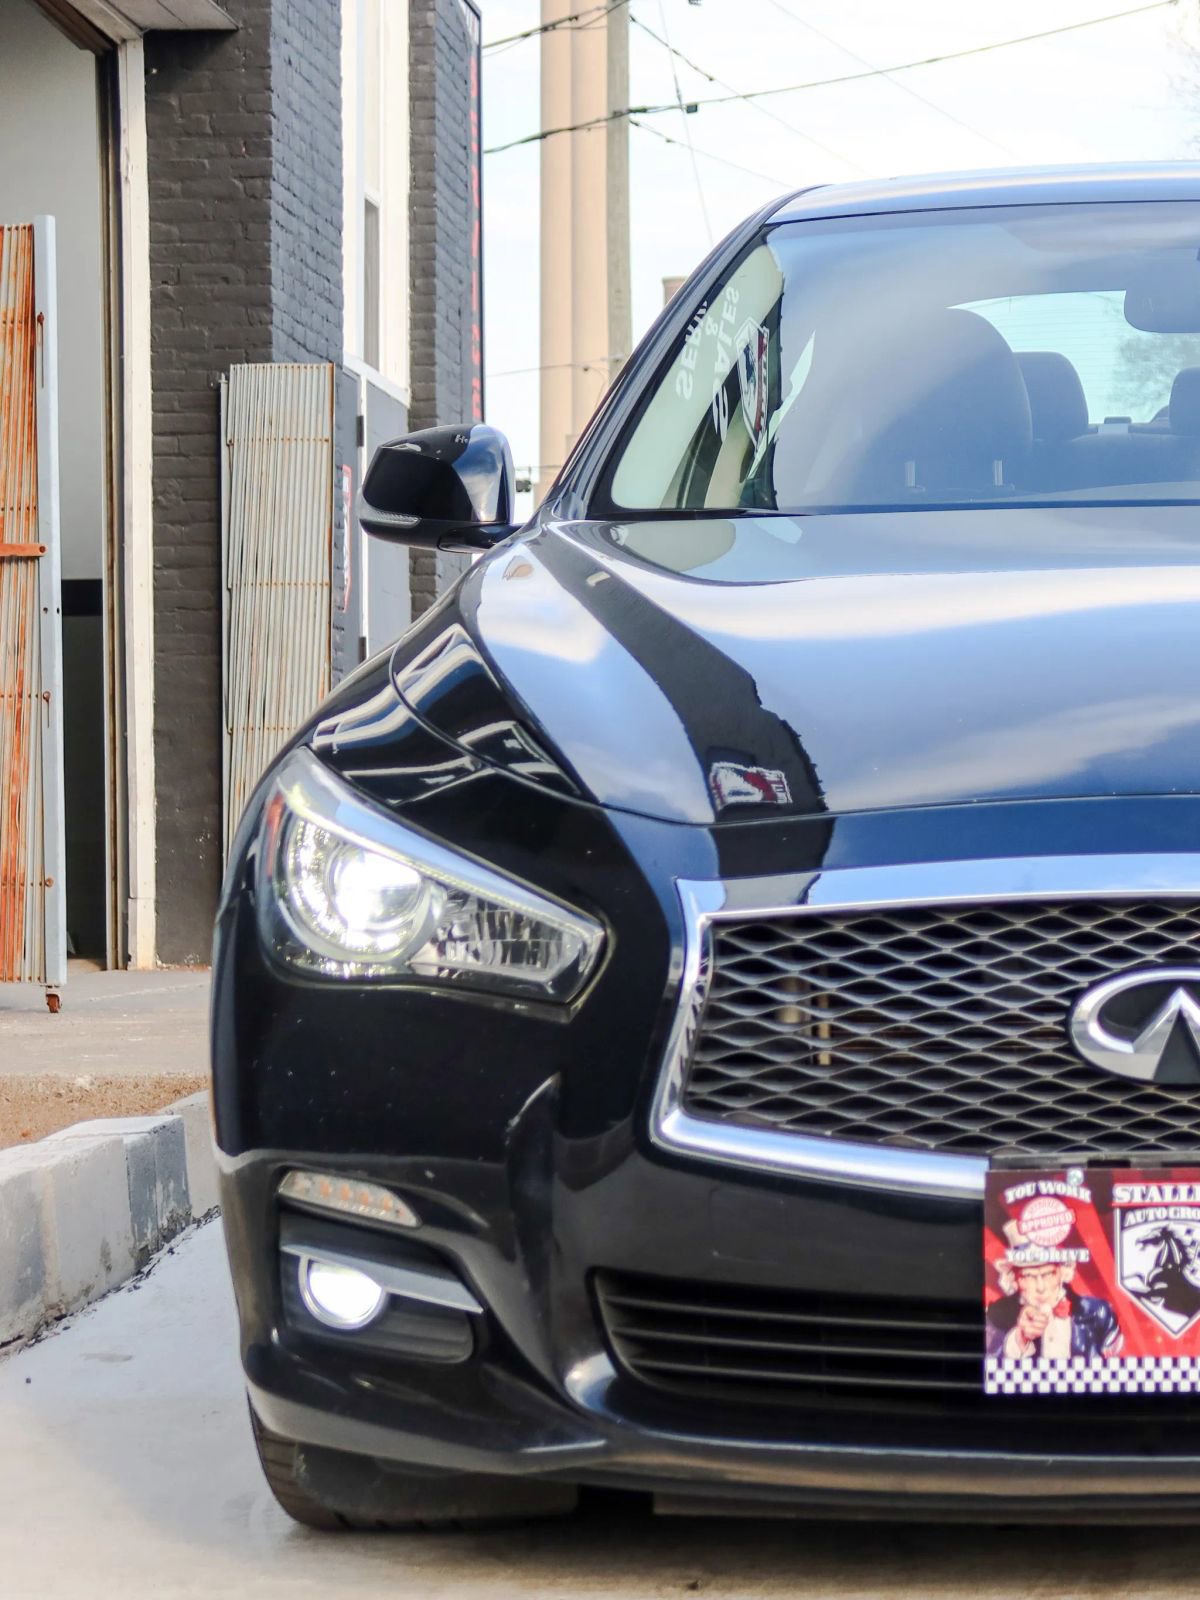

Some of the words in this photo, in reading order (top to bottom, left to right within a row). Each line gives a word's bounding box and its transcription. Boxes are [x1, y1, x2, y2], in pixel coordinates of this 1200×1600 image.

[1004, 1182, 1037, 1204] YOU
[1038, 1180, 1092, 1204] WORK
[1020, 1210, 1073, 1235] APPROVED
[1124, 1206, 1168, 1228] AUTO
[1005, 1249, 1039, 1263] YOU
[1039, 1248, 1090, 1263] DRIVE
